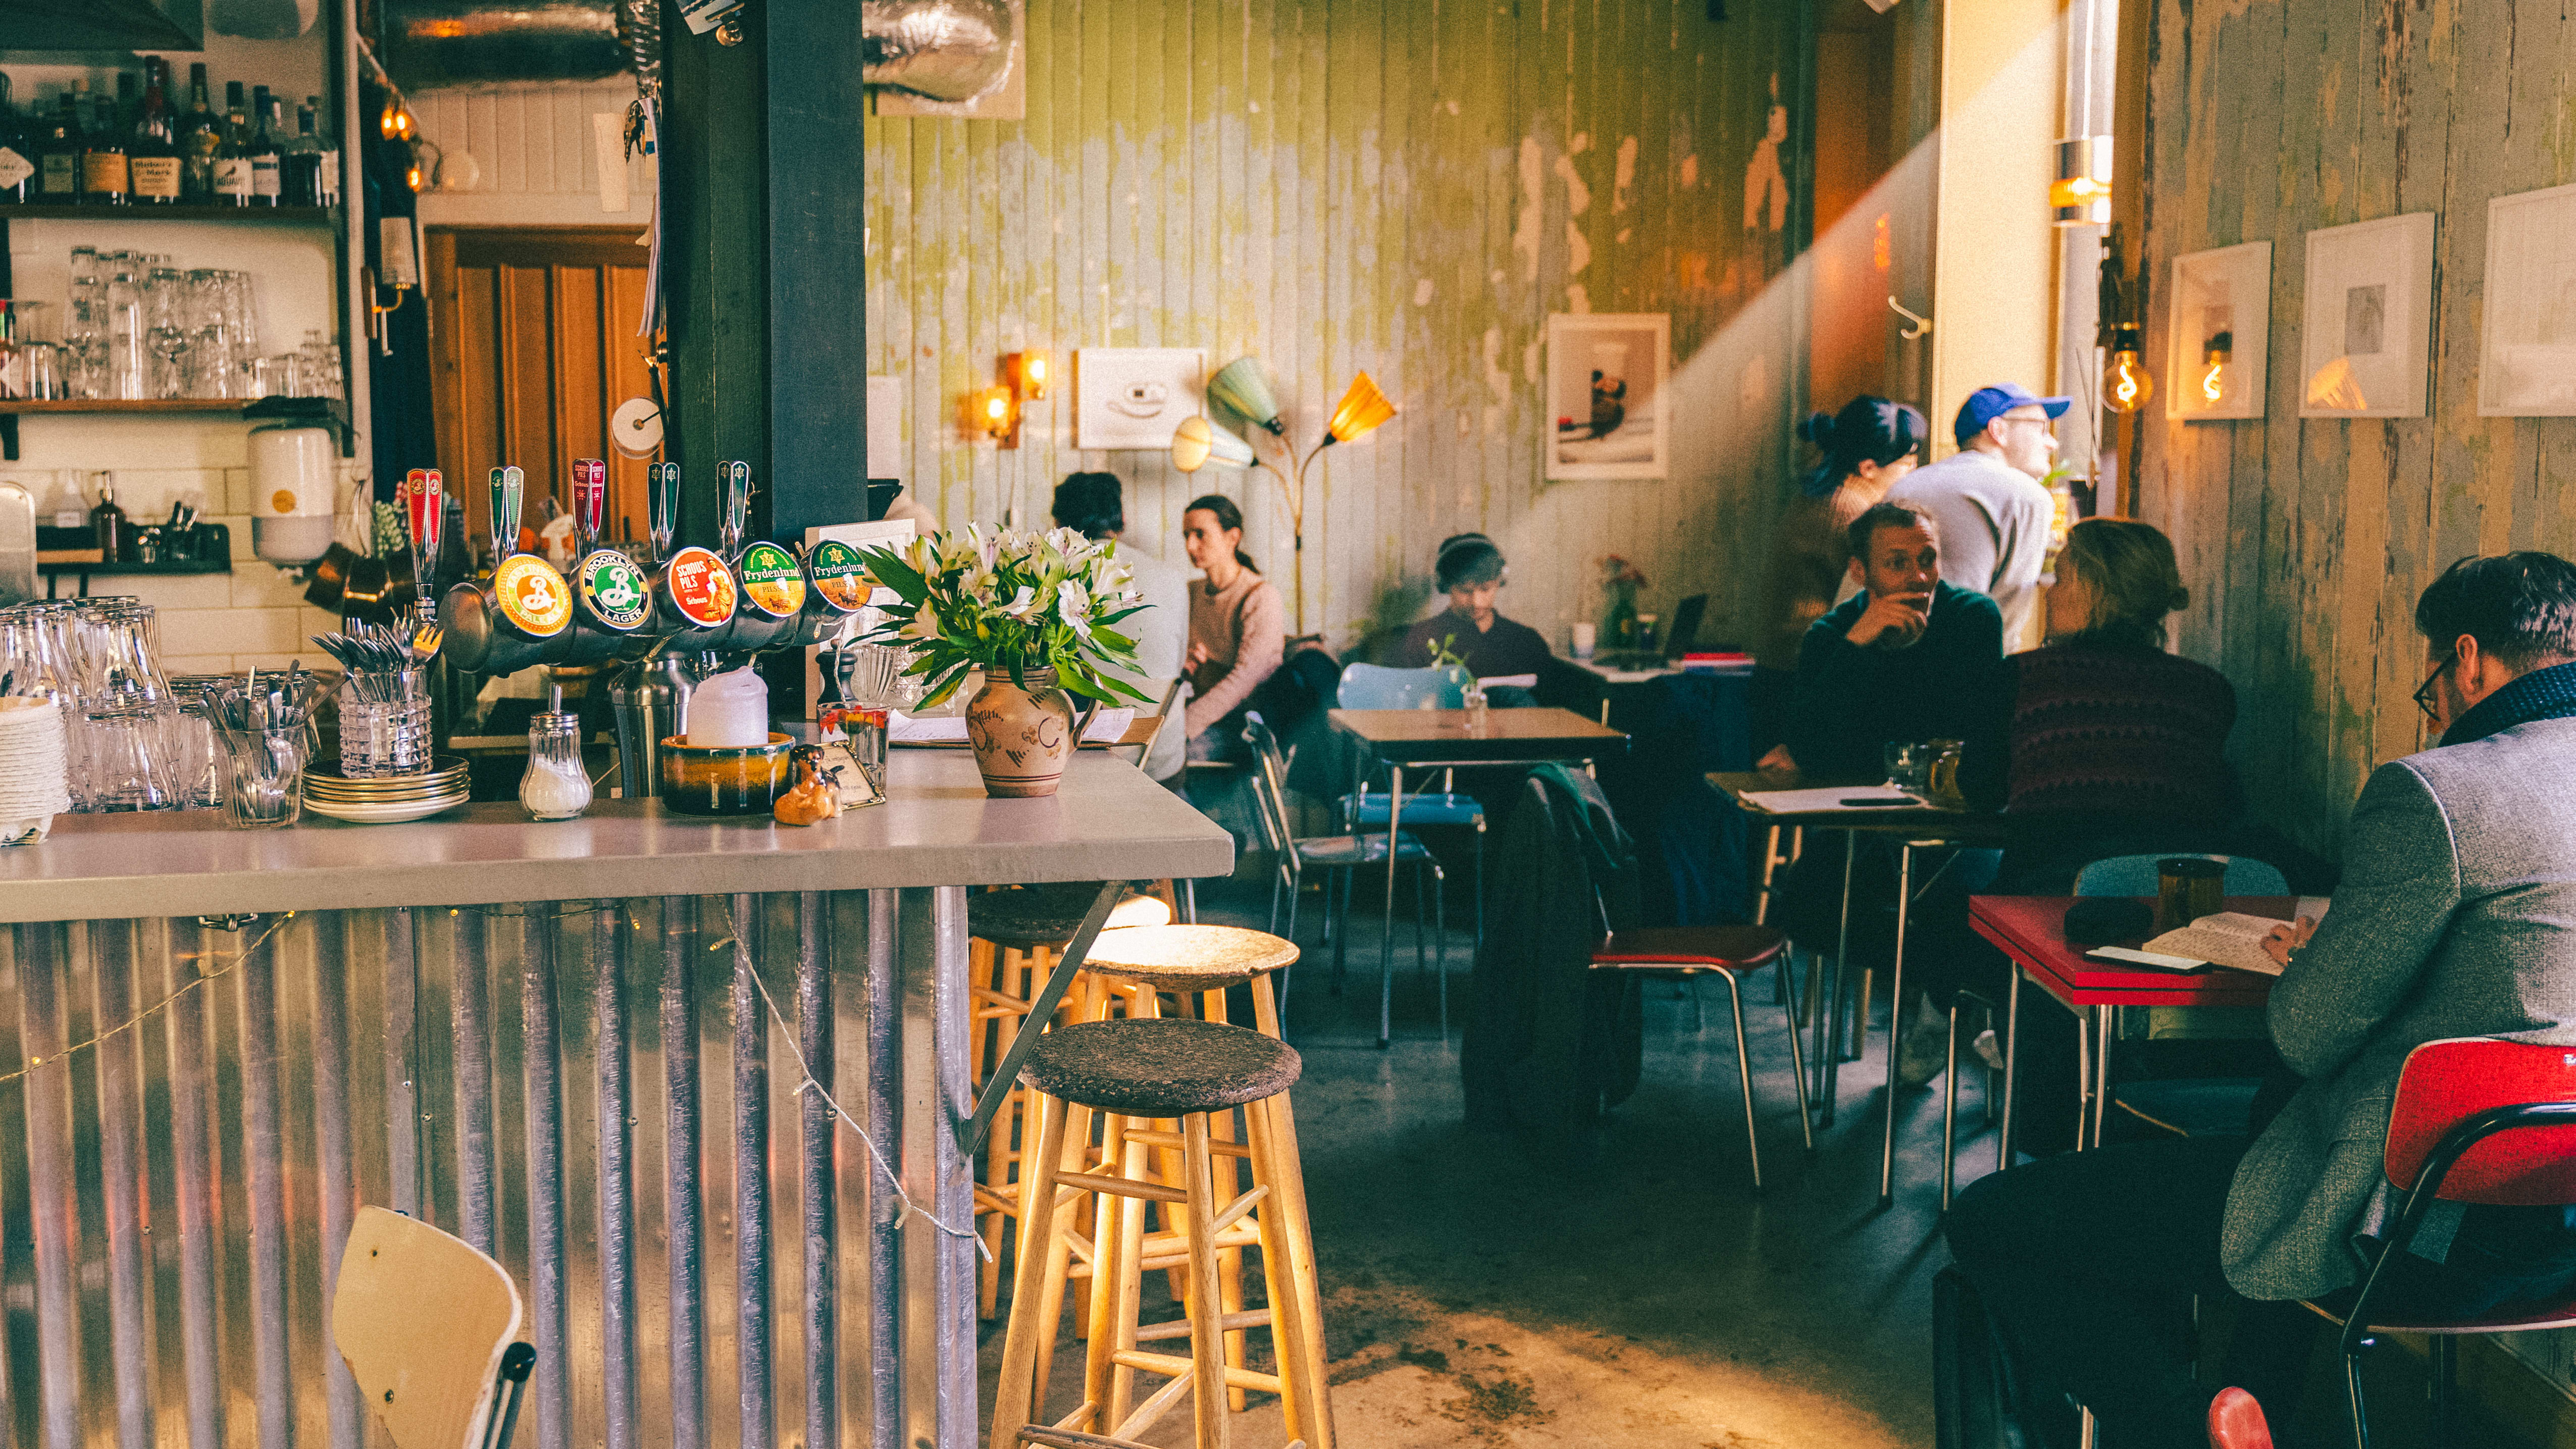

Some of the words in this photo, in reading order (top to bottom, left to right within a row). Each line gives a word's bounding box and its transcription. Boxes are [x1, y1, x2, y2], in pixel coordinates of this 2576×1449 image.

[585, 555, 639, 580] BROOKLYN
[676, 560, 707, 577] SCHOUS
[743, 567, 801, 581] Frydenlund
[679, 575, 698, 590] PILS
[832, 580, 860, 588] PILSR
[686, 597, 708, 605] Schous
[520, 609, 548, 623] PALE
[604, 607, 643, 623] LAGER
